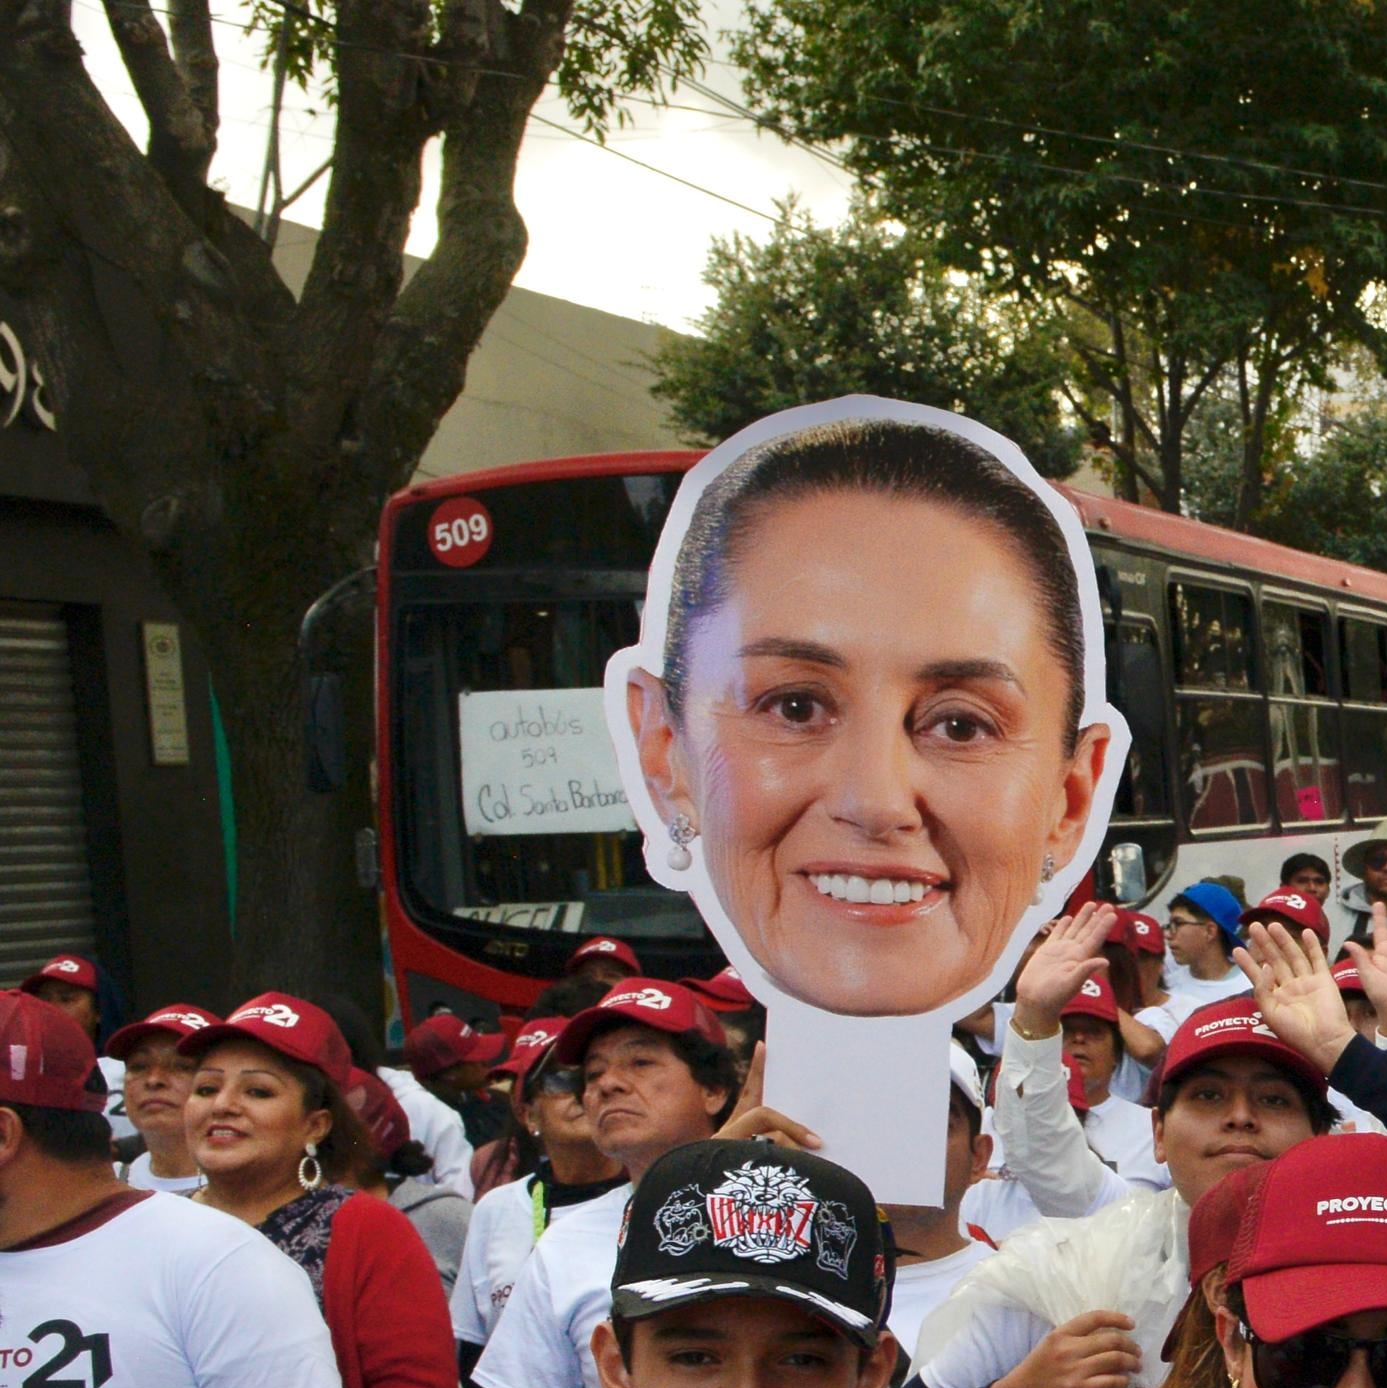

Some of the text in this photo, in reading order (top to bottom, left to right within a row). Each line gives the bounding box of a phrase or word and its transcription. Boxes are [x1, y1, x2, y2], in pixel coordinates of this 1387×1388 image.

[434, 514, 488, 550] 509
[641, 988, 671, 1009] 21
[264, 1004, 299, 1028] 21
[1194, 1016, 1260, 1036] PROYECTO
